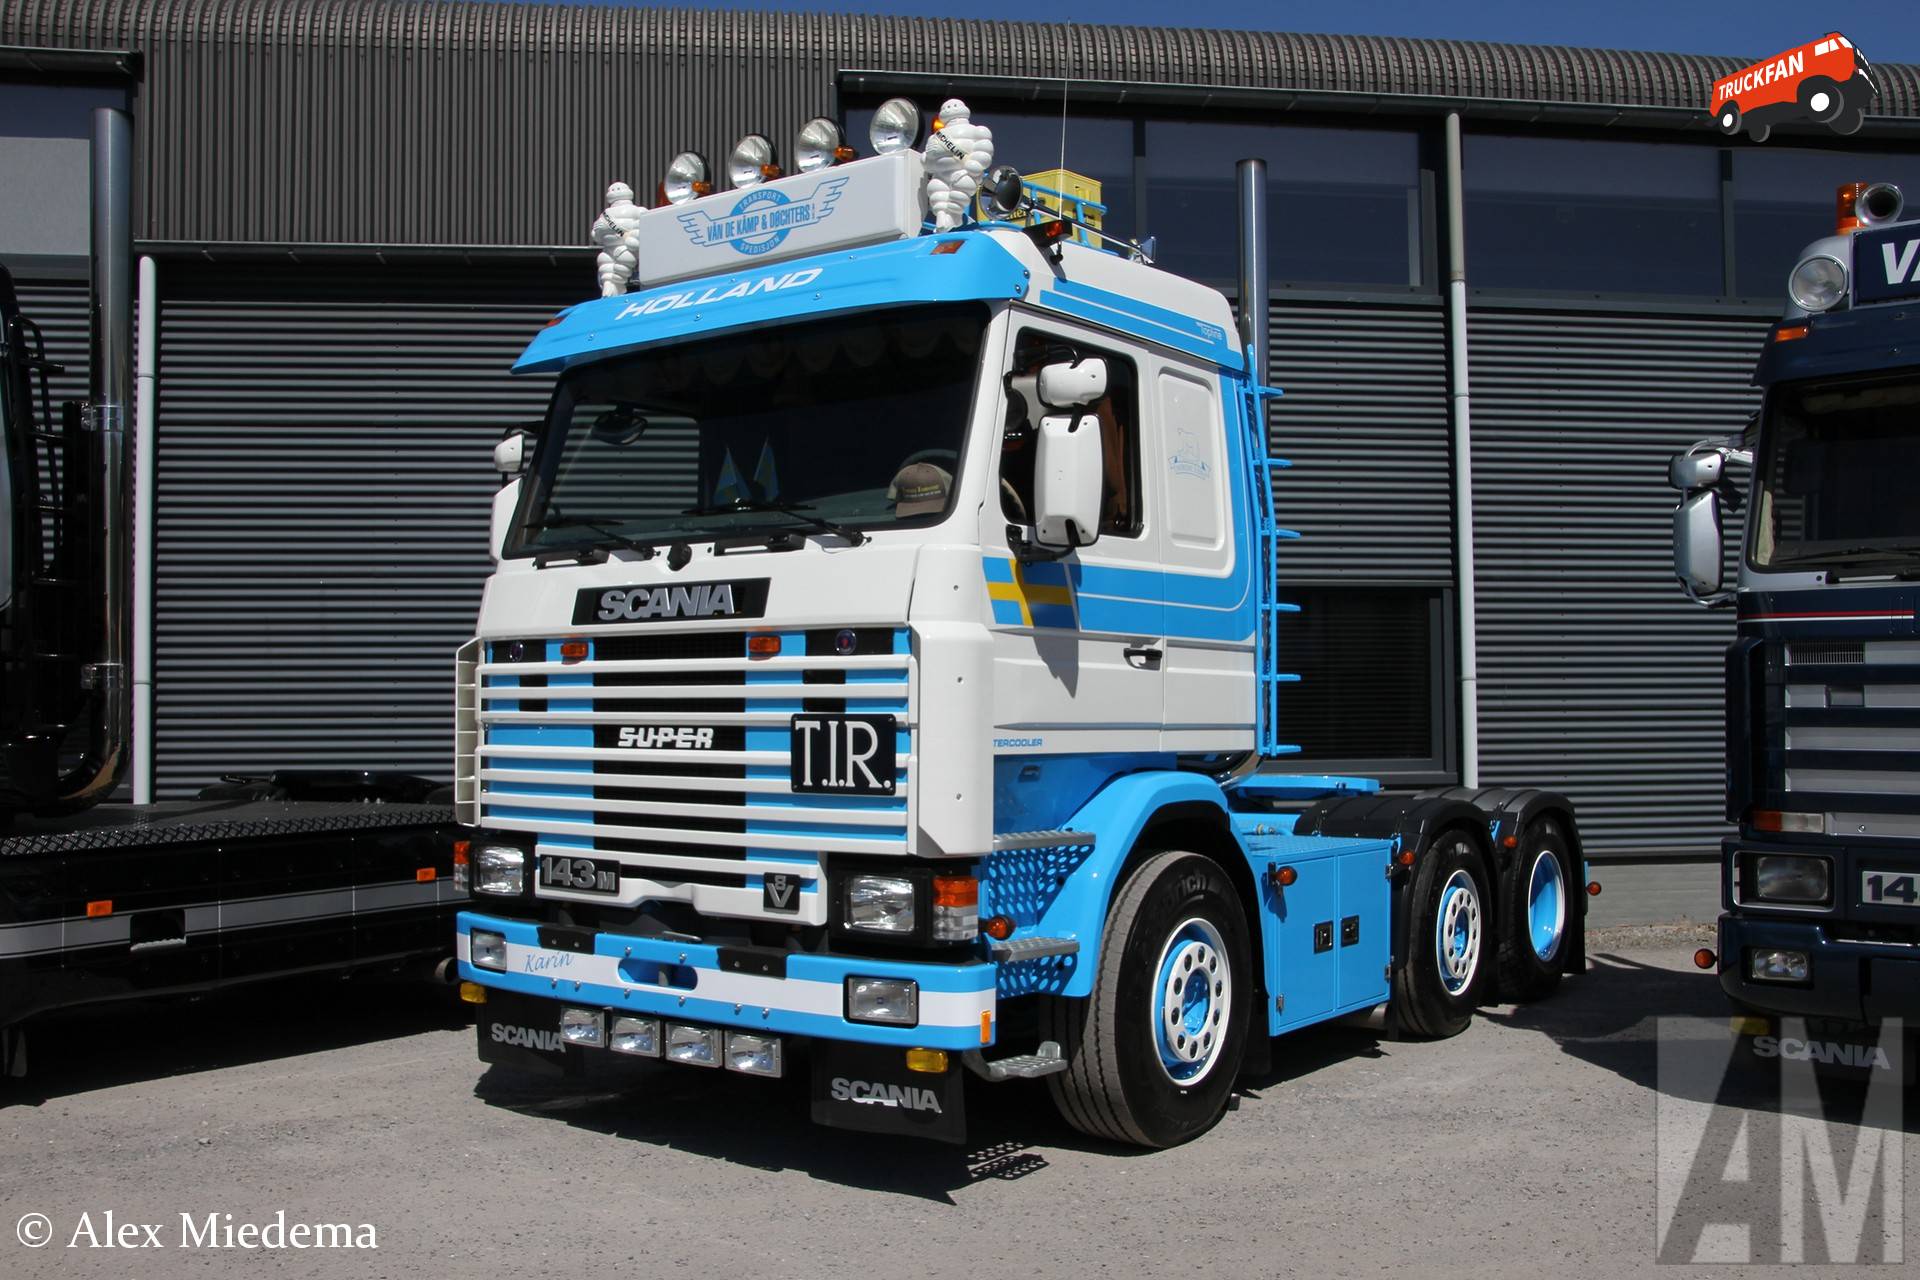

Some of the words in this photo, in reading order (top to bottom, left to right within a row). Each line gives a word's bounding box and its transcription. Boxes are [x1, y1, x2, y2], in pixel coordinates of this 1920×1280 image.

[738, 190, 781, 210] TRANSPORT
[725, 220, 735, 238] DE
[761, 214, 767, 230] &
[614, 267, 824, 321] HOLLAND
[597, 583, 735, 621] SCANIA
[618, 726, 714, 749] SUPER
[795, 719, 892, 789] T.I.R.
[1867, 874, 1920, 903] 14
[525, 951, 574, 973] Karin
[491, 1023, 567, 1053] SCANIA
[1753, 1036, 1891, 1070] SCANIA
[831, 1077, 943, 1114] SCANIA
